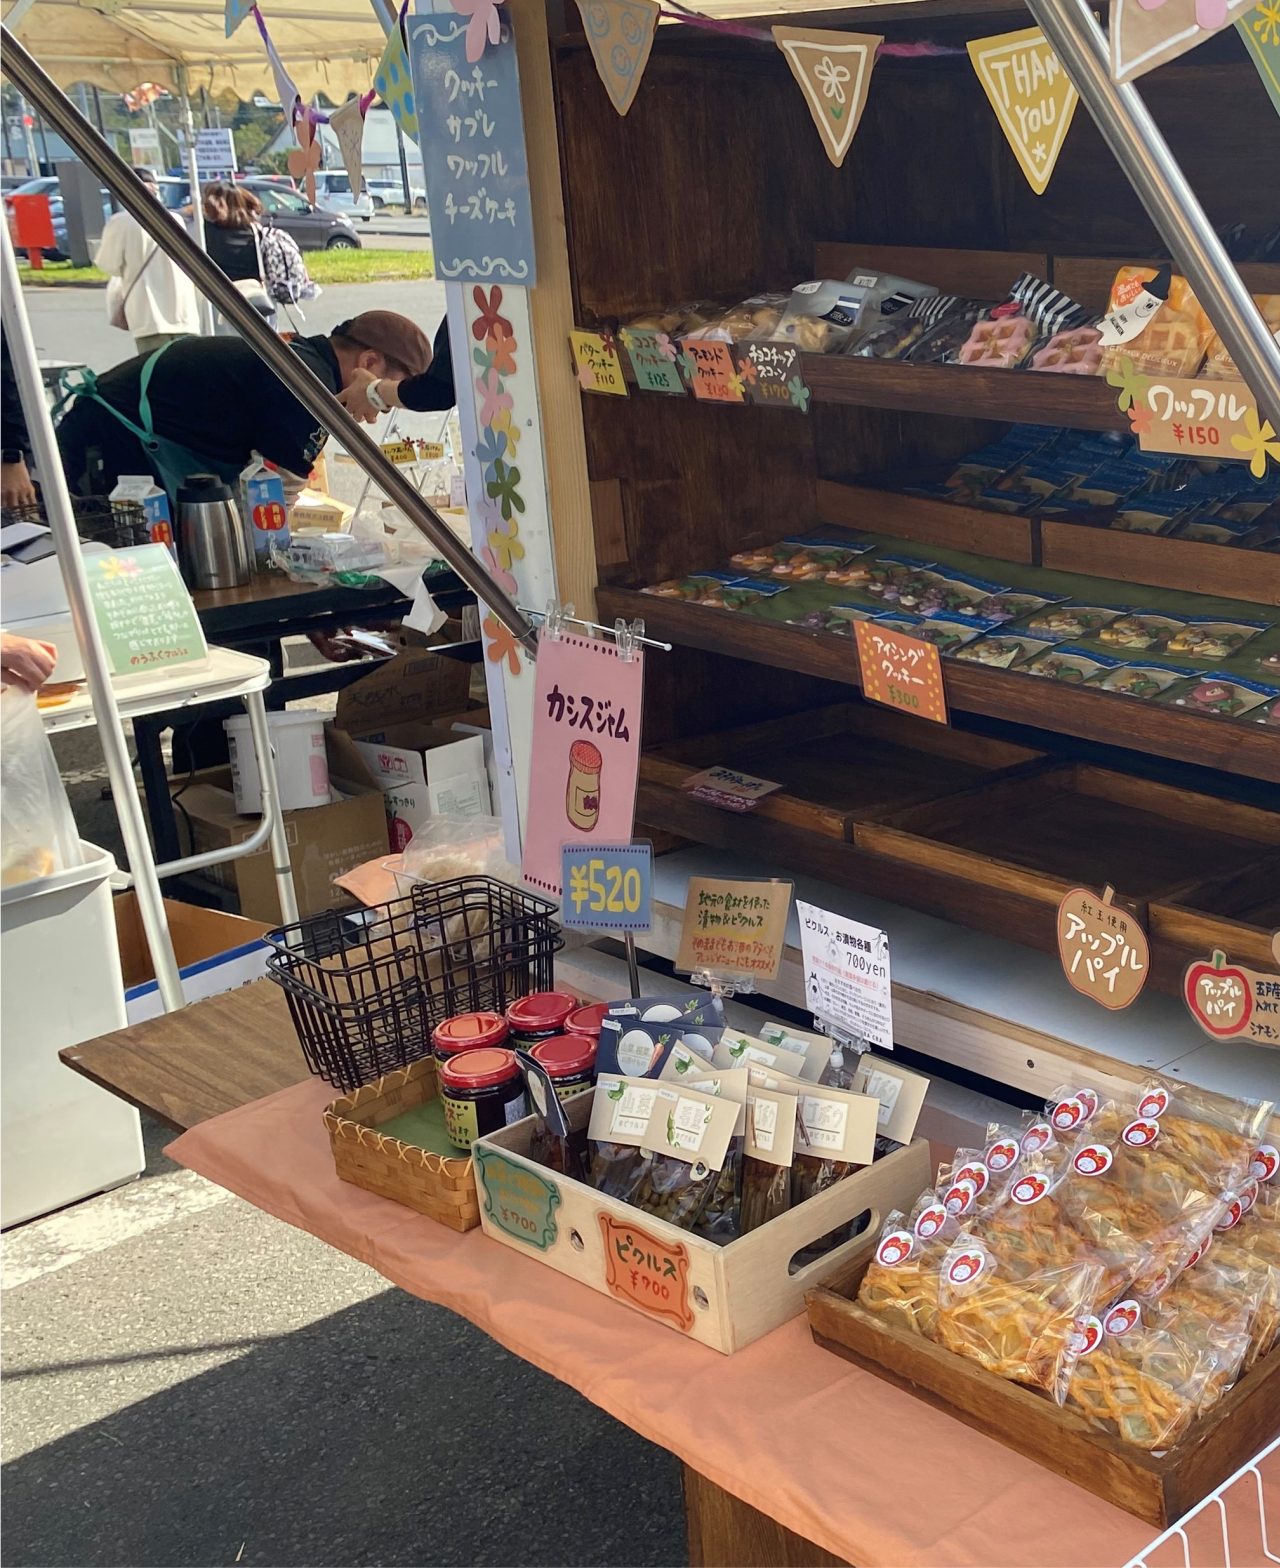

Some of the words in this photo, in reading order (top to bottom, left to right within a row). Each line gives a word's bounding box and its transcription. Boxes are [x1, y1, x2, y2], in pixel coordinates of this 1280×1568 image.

[444, 65, 498, 102] クッキー
[990, 49, 1069, 110] THAN
[447, 108, 495, 143] サブレ
[1014, 97, 1056, 144] YOU
[447, 151, 508, 179] ワッフル
[445, 187, 516, 228] チーズケーキ
[588, 358, 615, 370] クッキー
[636, 353, 669, 366] クッキー
[689, 346, 724, 361] アーモンド
[748, 343, 797, 367] チョコチップ
[594, 372, 616, 386] ¥110
[647, 372, 670, 388] ¥125
[697, 366, 724, 378] クッキー
[757, 365, 786, 382] スコーン
[760, 382, 789, 399] ¥170
[1148, 384, 1248, 422] ワッフル
[1172, 423, 1220, 446] ¥150
[872, 636, 925, 667] アイシング
[881, 660, 925, 685] クッキー
[546, 684, 630, 743] カシスジャム
[570, 858, 641, 915] ¥520
[1065, 912, 1144, 970] アップル
[846, 951, 886, 978] 700yen
[1070, 949, 1120, 993] パイ
[1200, 978, 1243, 998] アップル
[1206, 999, 1237, 1017] パイ
[501, 1206, 538, 1234] ¥700
[615, 1235, 678, 1282] ピクルス
[630, 1268, 670, 1301] ¥700
